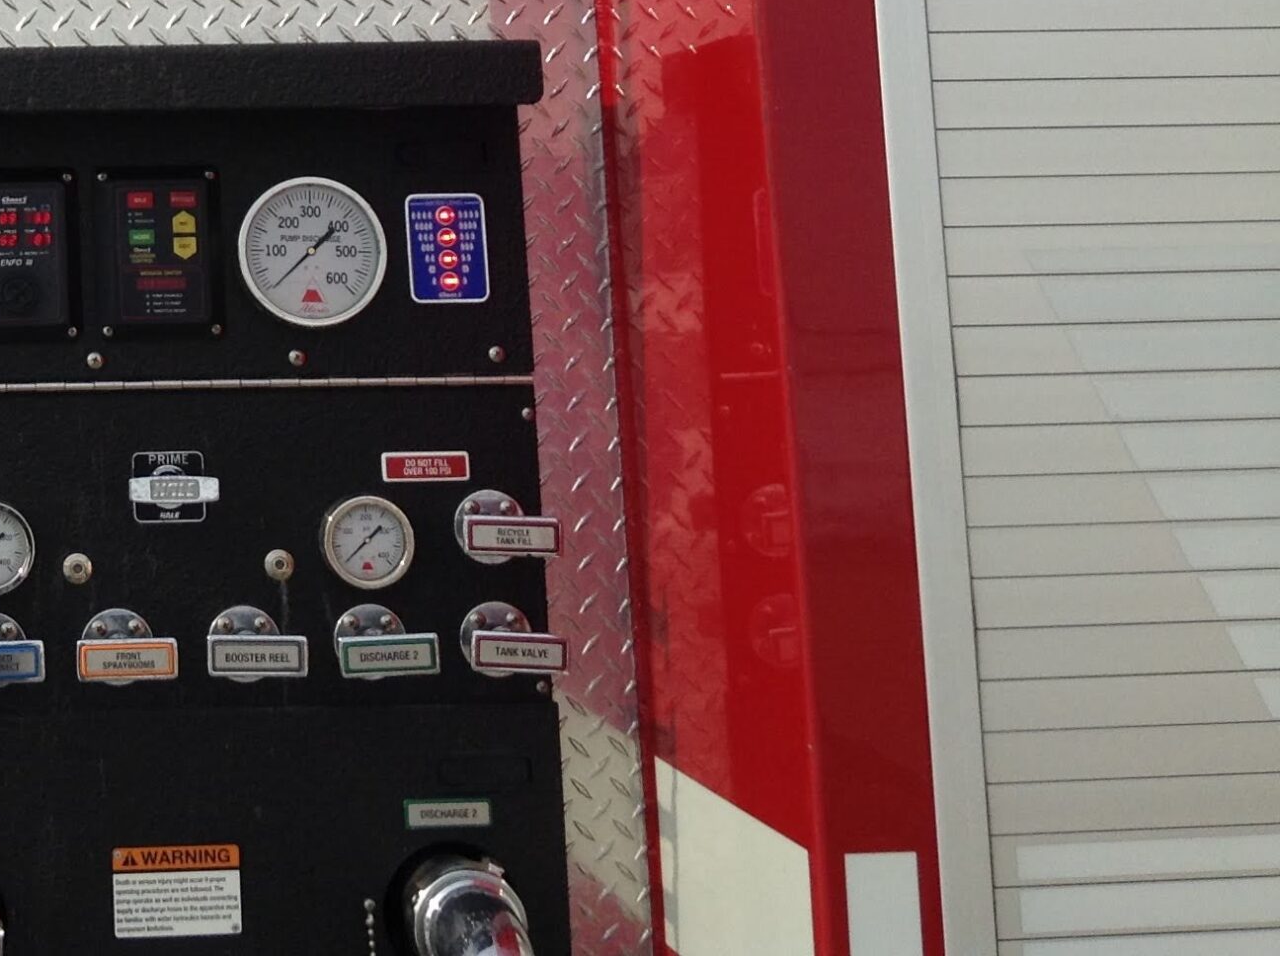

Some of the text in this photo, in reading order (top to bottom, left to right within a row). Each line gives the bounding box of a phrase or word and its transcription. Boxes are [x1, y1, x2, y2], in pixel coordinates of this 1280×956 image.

[300, 206, 321, 217] 300
[278, 217, 299, 228] 200
[328, 221, 348, 232] 400
[266, 245, 286, 256] 100
[336, 246, 356, 257] 500
[327, 273, 347, 284] 600
[149, 454, 189, 464] PRIME
[405, 459, 415, 467] DO
[403, 467, 423, 475] OVER
[425, 467, 438, 475] 100
[498, 528, 529, 536] RECYCLE
[116, 652, 141, 661] FRONT
[360, 651, 419, 662] DISCHARGE 2
[495, 646, 549, 658] TANK VALVE
[225, 653, 290, 663] BOOSTER REEL
[420, 809, 477, 819] DISCHARGE 2
[141, 849, 230, 865] WARNING
